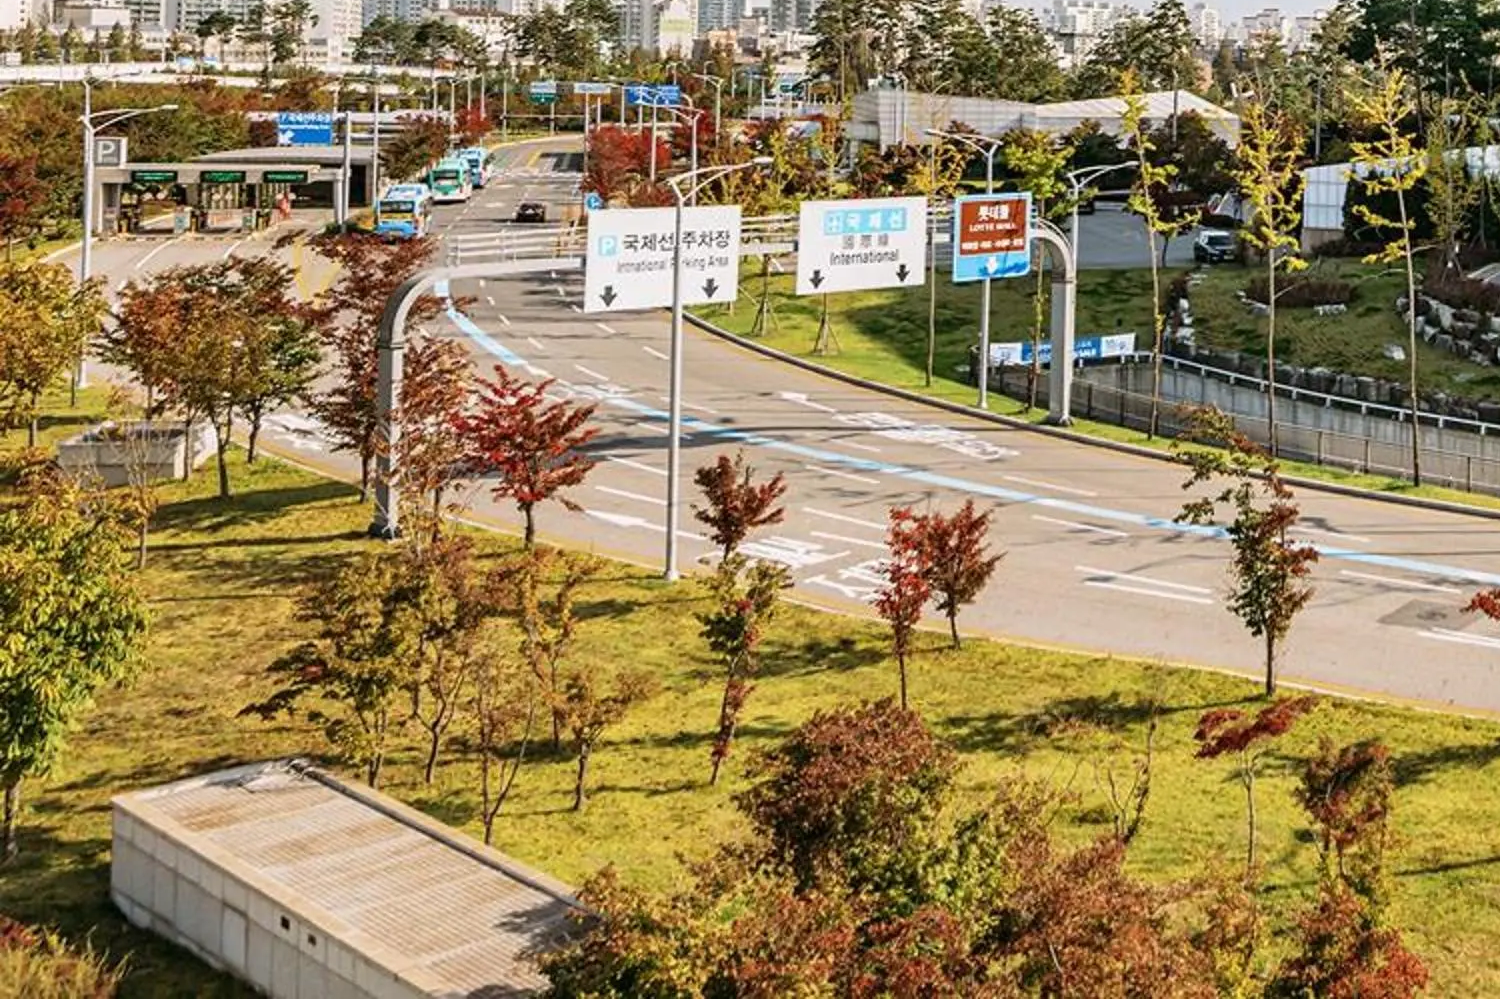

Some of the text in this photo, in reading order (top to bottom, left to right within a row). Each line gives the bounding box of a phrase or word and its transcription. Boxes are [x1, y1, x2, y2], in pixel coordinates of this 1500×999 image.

[98, 141, 115, 163] P
[682, 230, 731, 249] 주차장
[830, 249, 899, 265] International
